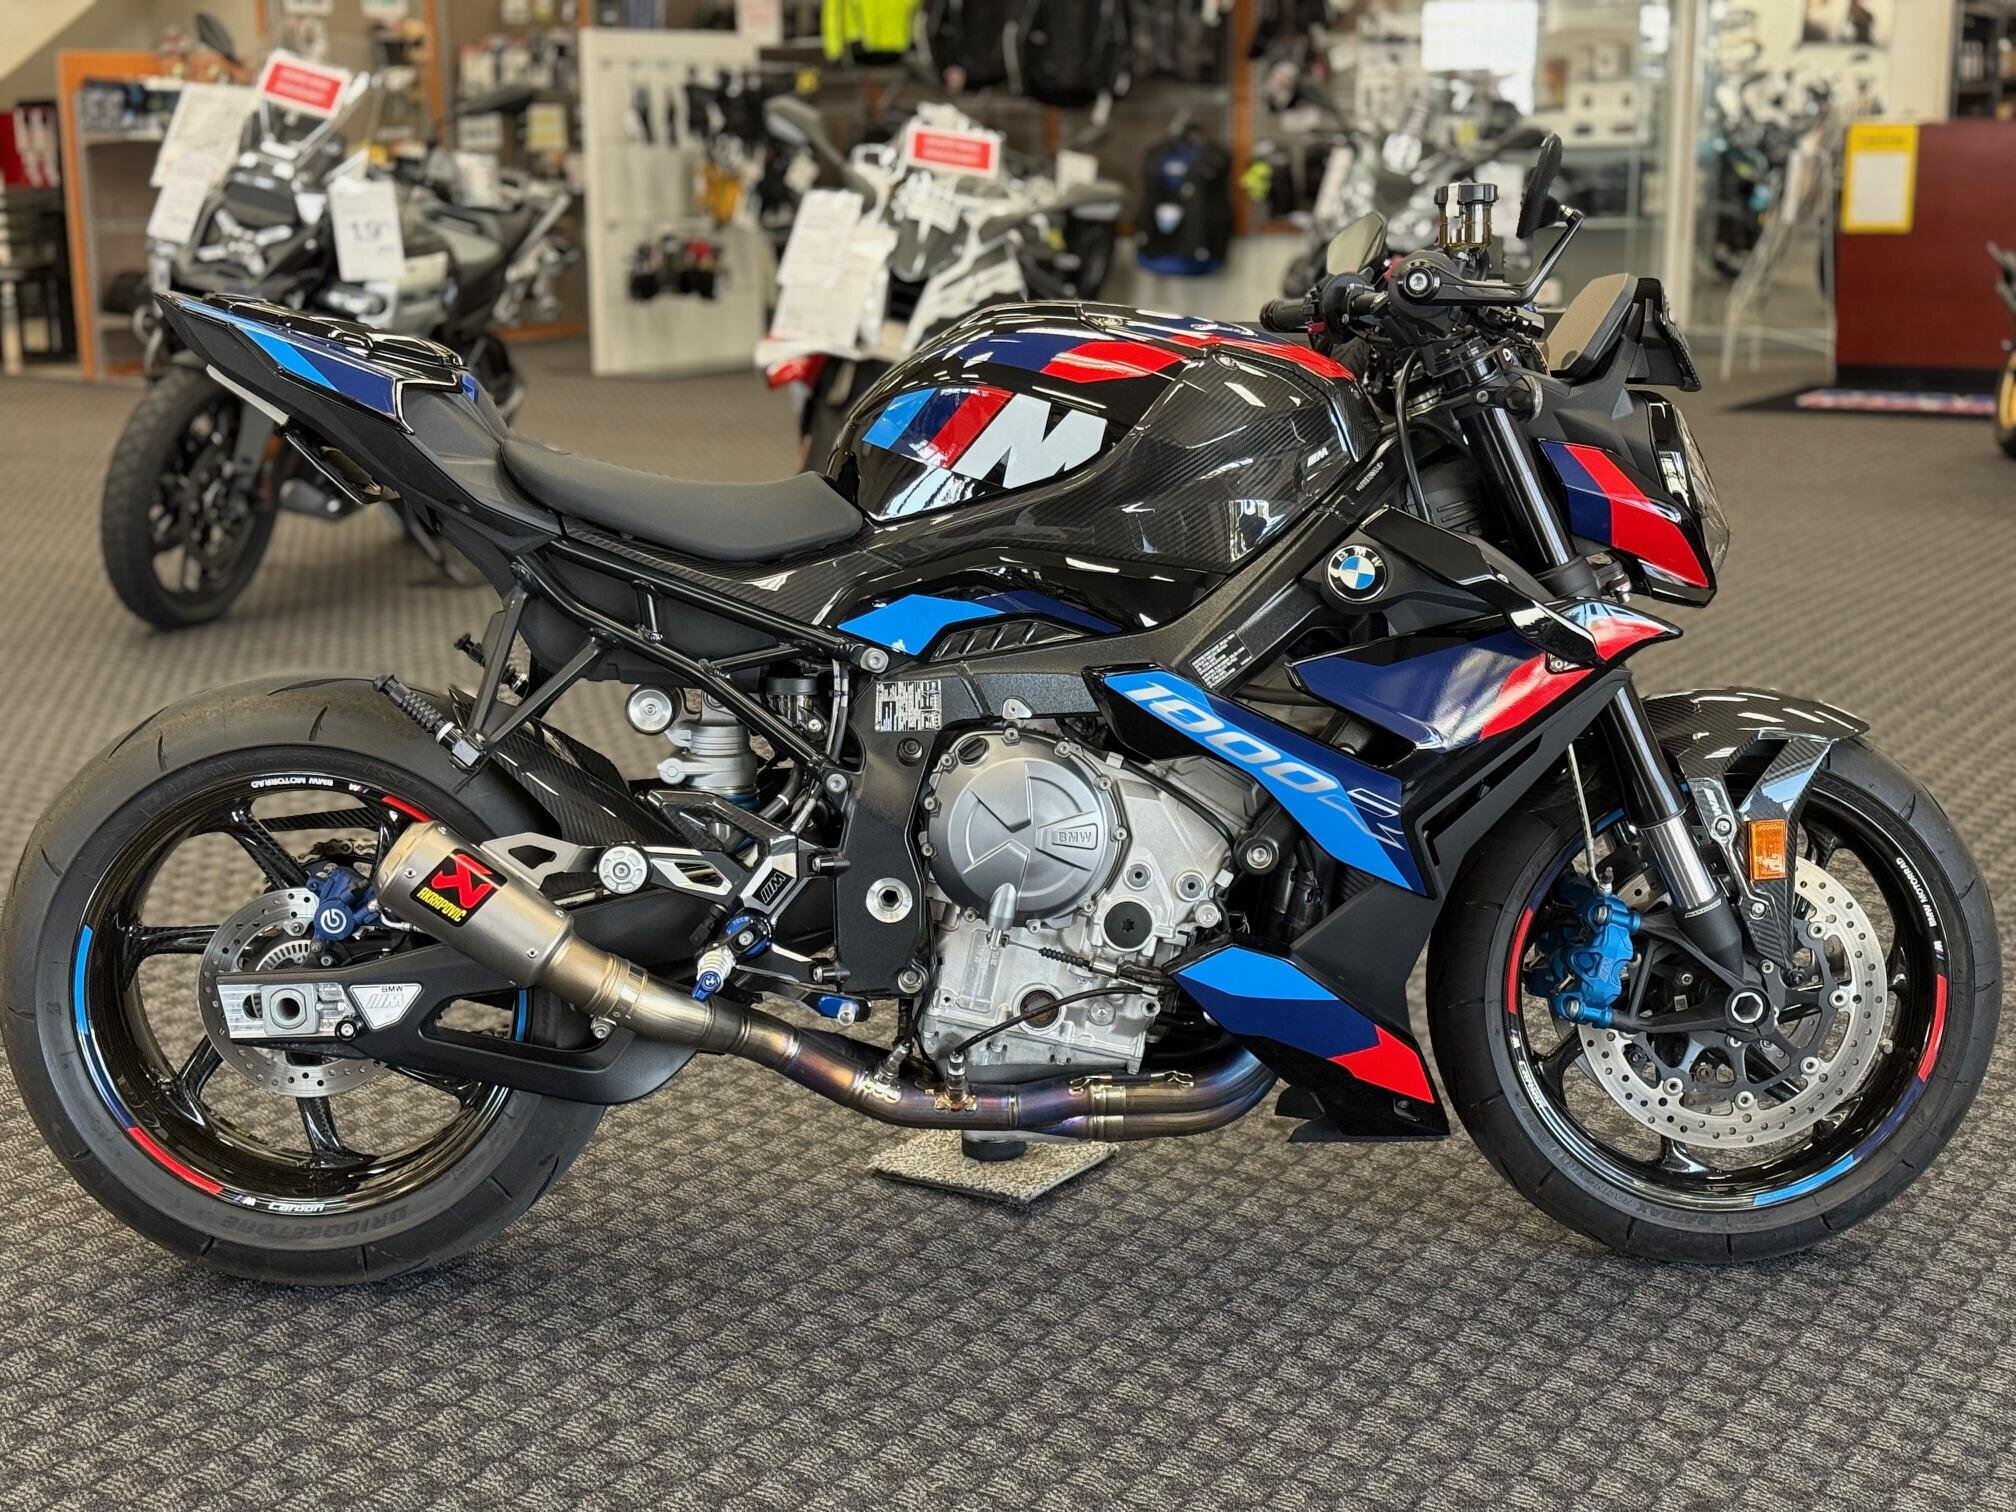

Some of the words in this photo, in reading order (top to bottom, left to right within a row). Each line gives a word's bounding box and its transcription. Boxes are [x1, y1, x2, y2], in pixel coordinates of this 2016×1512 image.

[1124, 681, 1338, 793] 1000
[251, 779, 306, 788] MOTORRAD
[1058, 831, 1091, 843] BMW
[1896, 857, 1928, 904] MOTORRAD
[1923, 904, 1937, 927] BMW
[382, 985, 404, 993] BMW
[268, 1201, 326, 1213] Carbon
